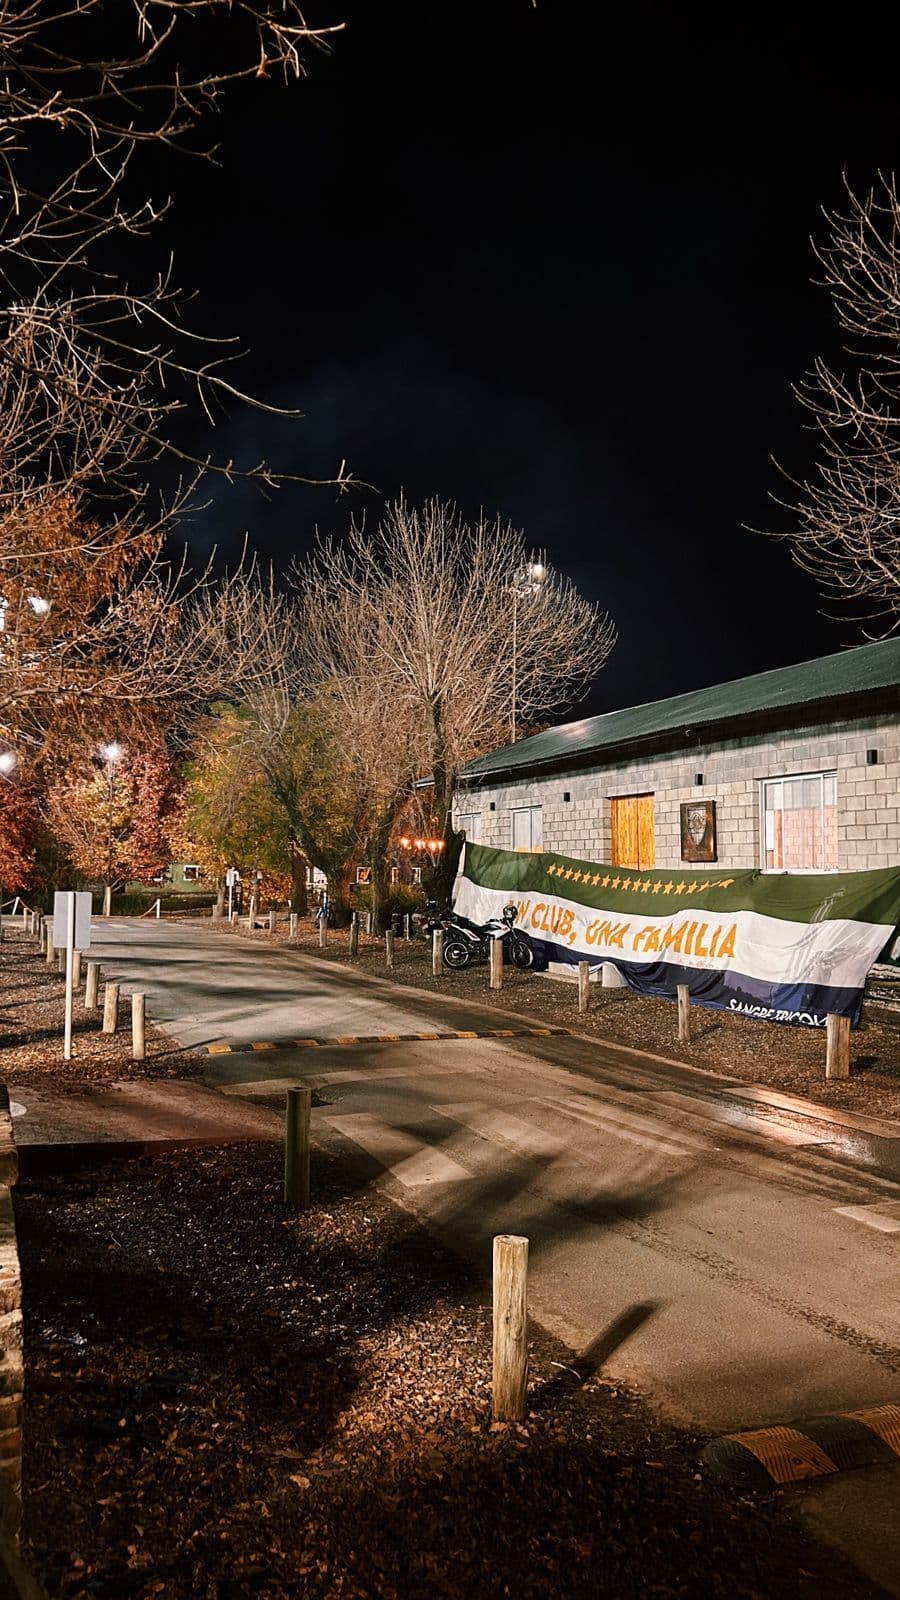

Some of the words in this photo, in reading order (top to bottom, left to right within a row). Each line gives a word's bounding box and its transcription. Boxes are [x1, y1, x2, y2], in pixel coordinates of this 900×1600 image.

[509, 899, 531, 926] N
[531, 902, 577, 945] CLUB,
[585, 919, 631, 949] UNA
[632, 920, 738, 959] FAMILIA
